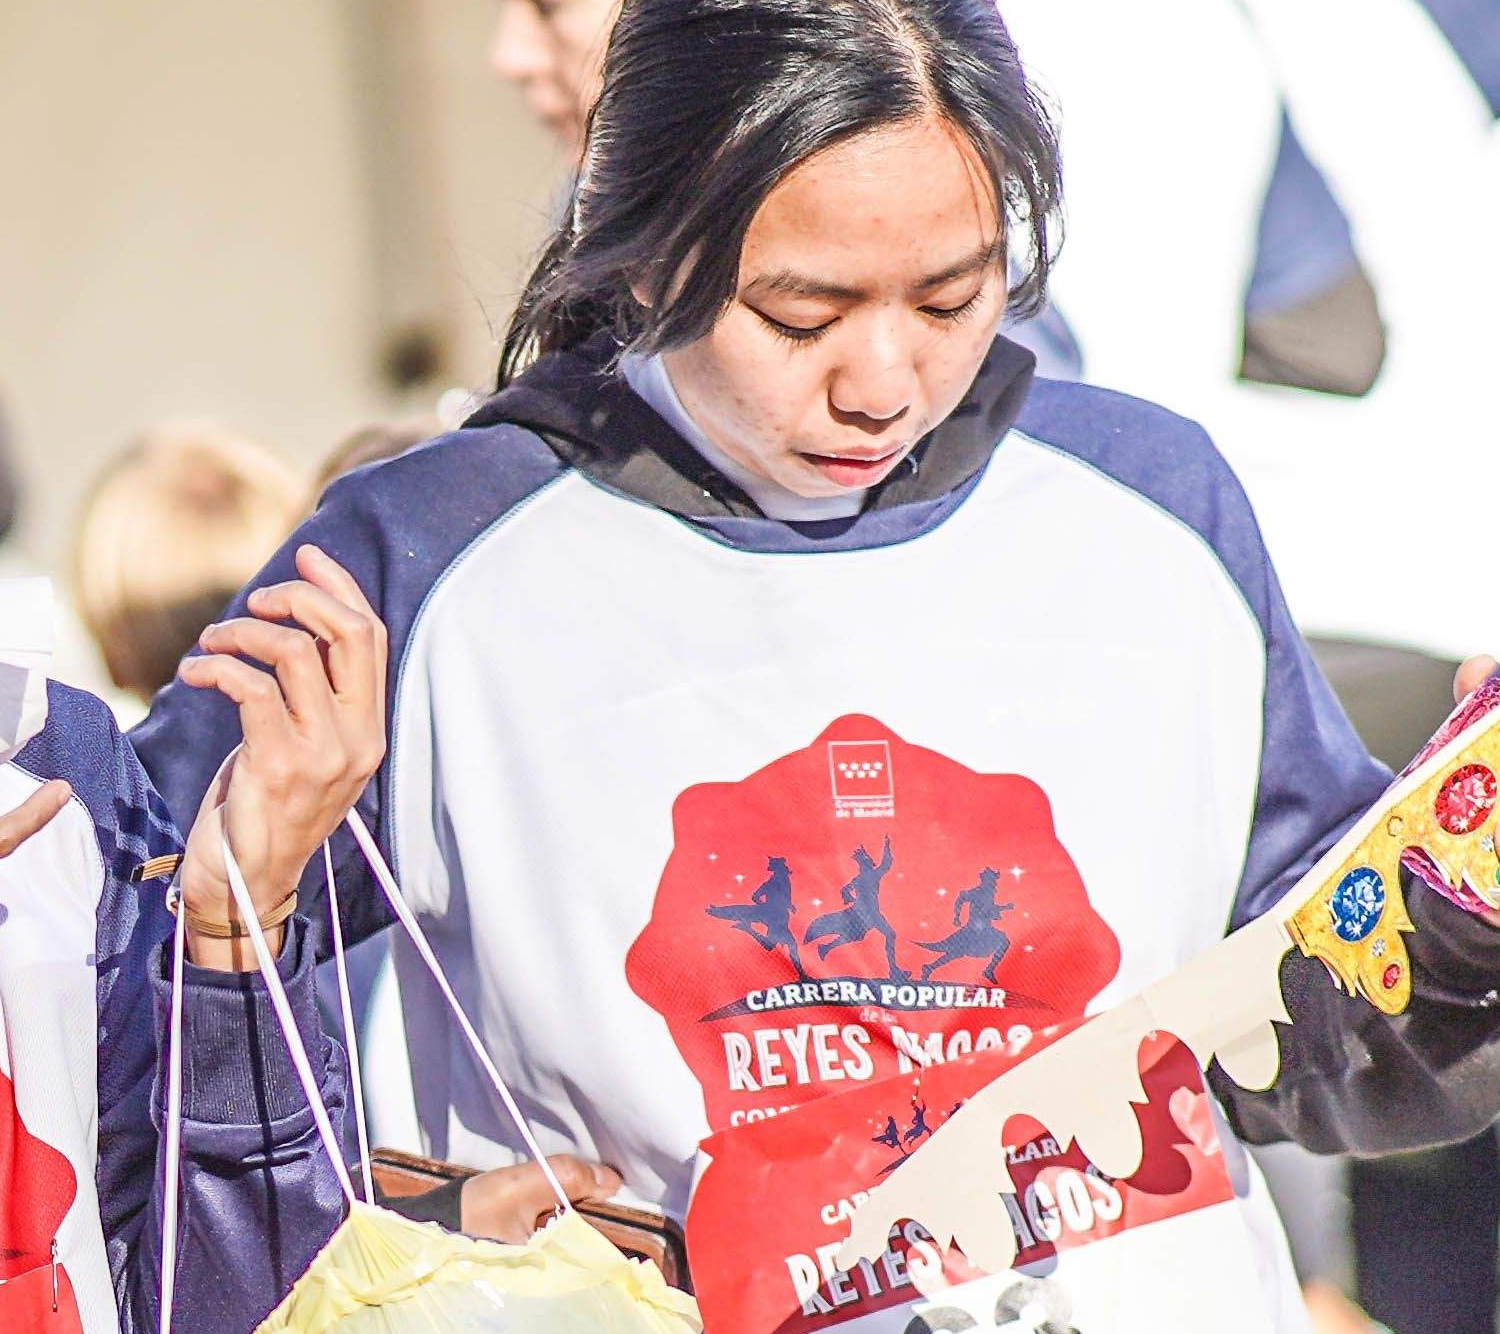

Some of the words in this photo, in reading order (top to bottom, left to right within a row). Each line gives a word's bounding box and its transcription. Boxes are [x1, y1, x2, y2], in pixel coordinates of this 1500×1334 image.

[746, 981, 875, 1011] CARRERA
[880, 984, 1007, 1009] POPULAR
[859, 1007, 877, 1023] de
[722, 1023, 873, 1091] REYES
[998, 1163, 1123, 1248] AGOS
